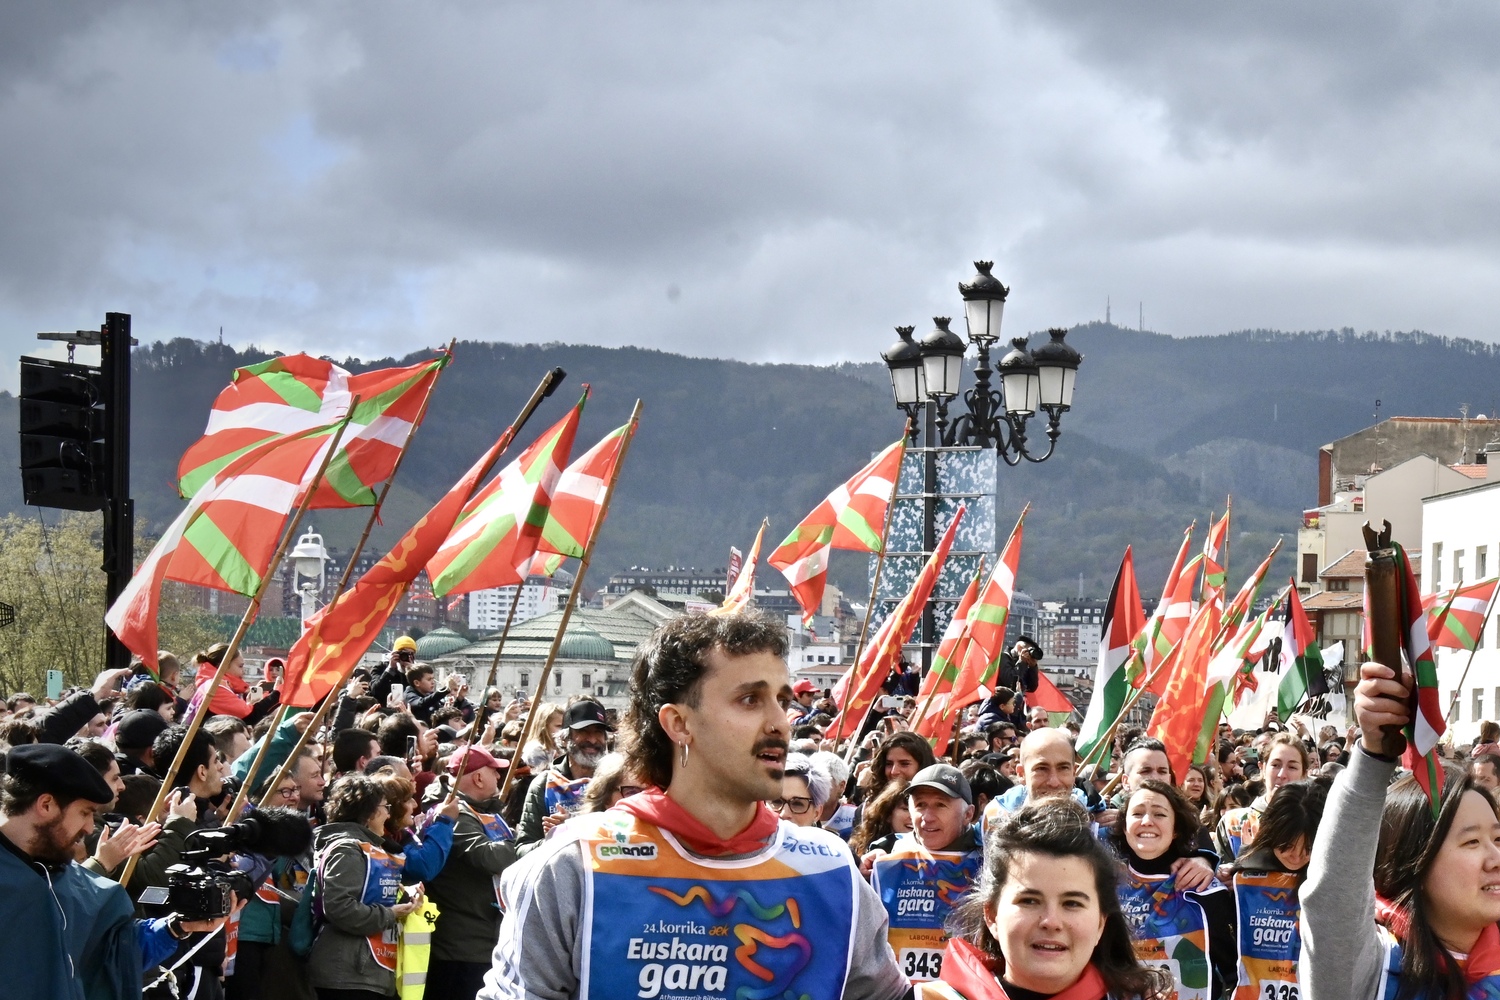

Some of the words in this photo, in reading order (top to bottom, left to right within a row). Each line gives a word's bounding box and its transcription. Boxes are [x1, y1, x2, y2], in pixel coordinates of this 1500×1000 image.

[897, 899, 935, 916] gara
[643, 920, 706, 935] 24.korrika
[1250, 916, 1294, 929] Euskara
[1253, 928, 1292, 945] gara
[627, 936, 728, 962] Euskara
[905, 952, 942, 978] 343
[637, 962, 728, 999] gara
